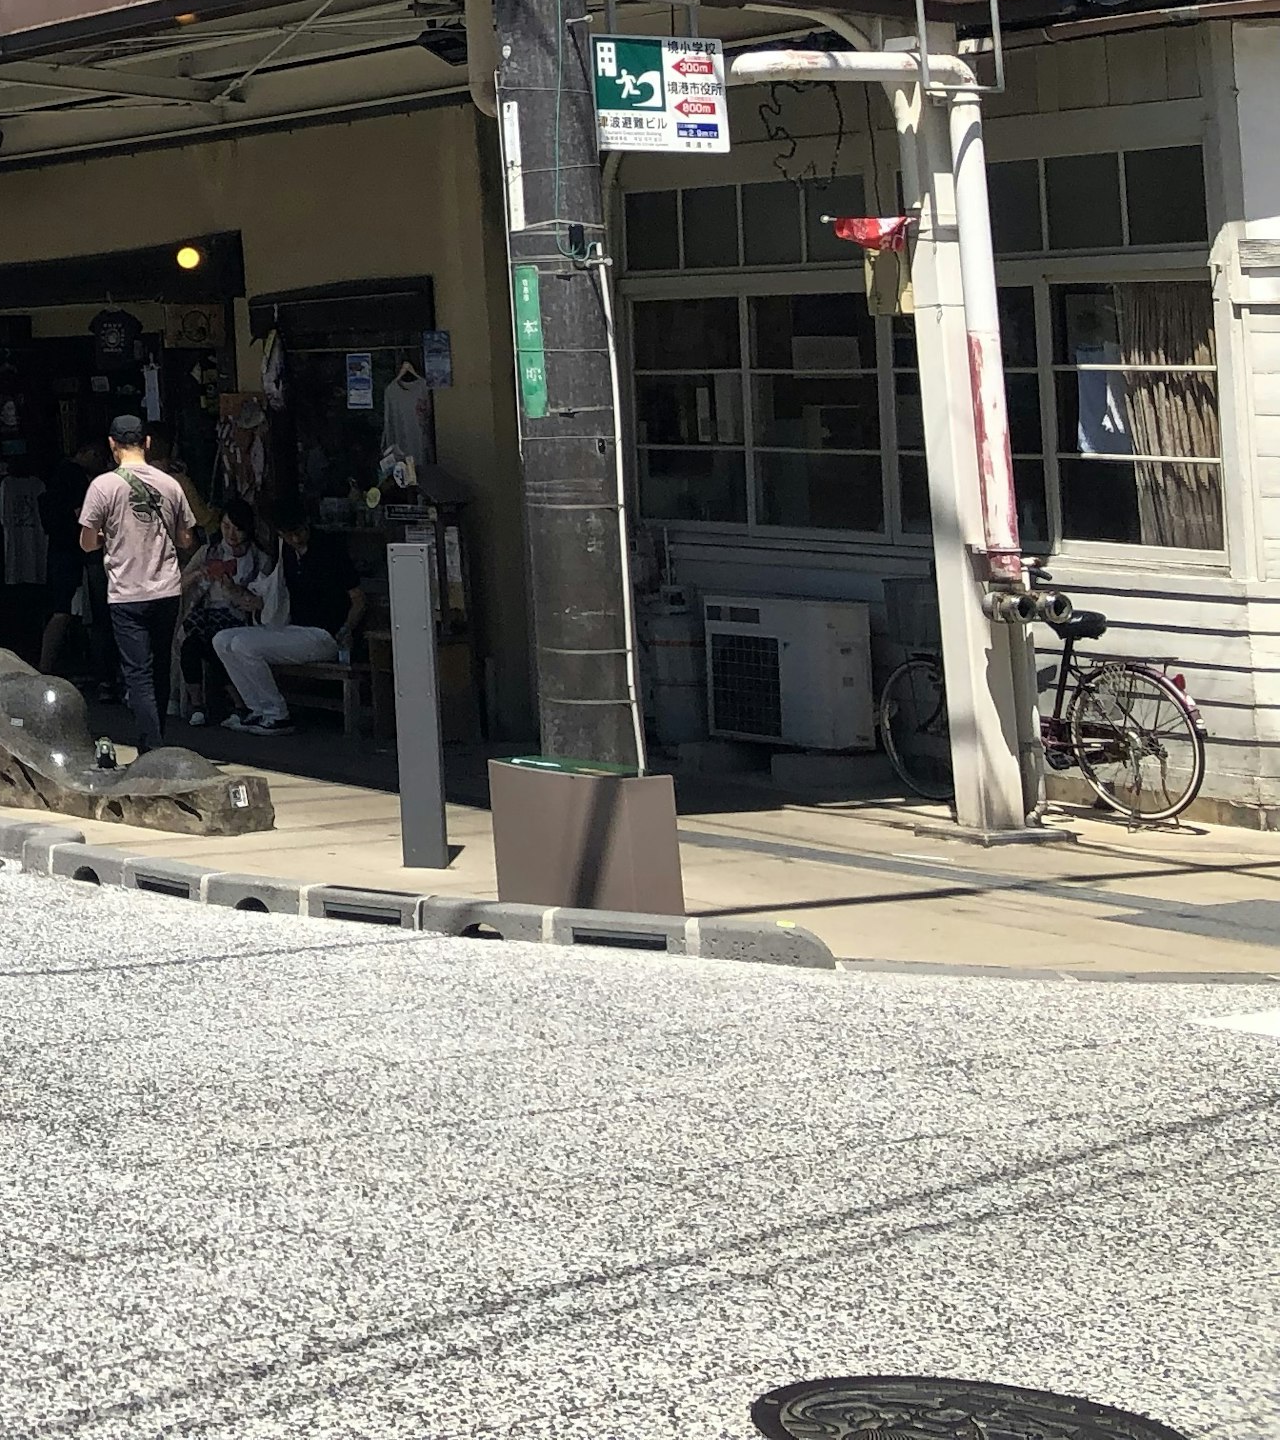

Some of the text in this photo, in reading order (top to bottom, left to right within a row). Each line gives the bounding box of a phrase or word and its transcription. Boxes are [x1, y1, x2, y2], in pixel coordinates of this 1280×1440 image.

[667, 40, 716, 55] 境小学校
[680, 62, 708, 73] 300m
[667, 81, 722, 96] 境港市役所
[597, 116, 668, 129] 津波避難ビル
